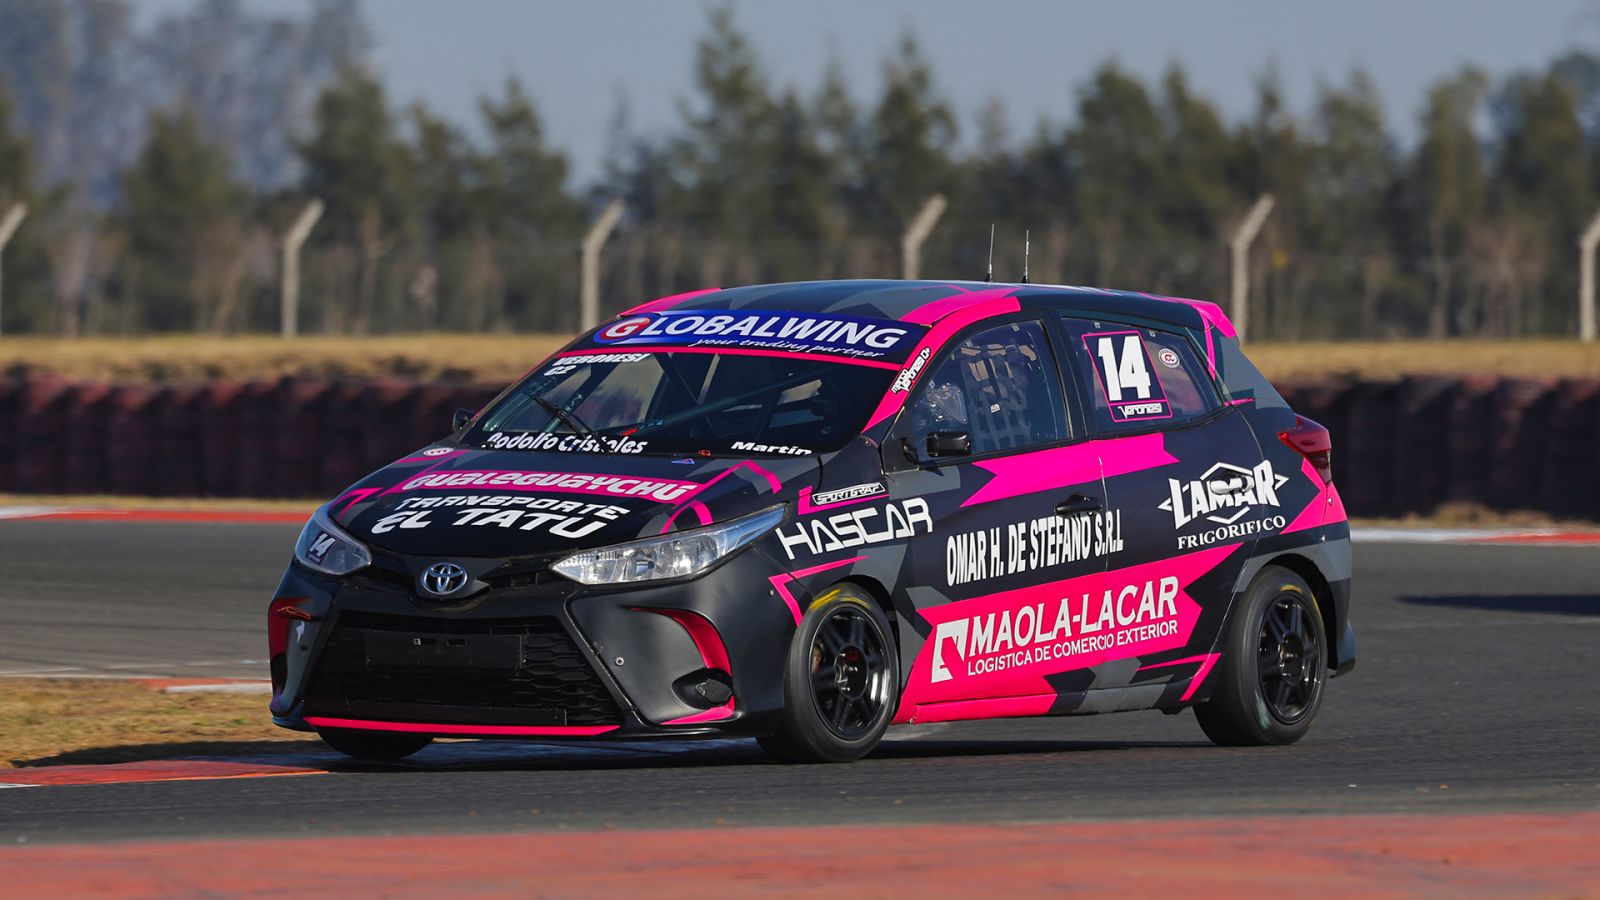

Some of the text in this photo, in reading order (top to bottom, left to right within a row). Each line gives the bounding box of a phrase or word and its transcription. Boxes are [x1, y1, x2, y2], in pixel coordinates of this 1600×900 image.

[605, 315, 907, 348] GLOBALWING
[688, 337, 885, 359] your trading partner
[552, 353, 651, 366] VERONESI
[1098, 335, 1151, 401] 14
[731, 441, 812, 455] Martin
[394, 495, 630, 520] TRANSPORTE
[1168, 459, 1281, 530] LAMAR
[452, 508, 608, 539] TATU
[774, 497, 933, 560] HASCAR
[1177, 515, 1286, 549] FRIGORIFICO
[309, 533, 336, 557] 14
[946, 530, 987, 586] OMAR
[990, 527, 1004, 578] H.
[1008, 522, 1026, 574] DE
[1030, 514, 1091, 570] STEFANO
[969, 575, 1179, 657] MAOLA-LACAR
[968, 619, 1178, 676] LOGISTICA DE COMERCIO EXTERIOR
